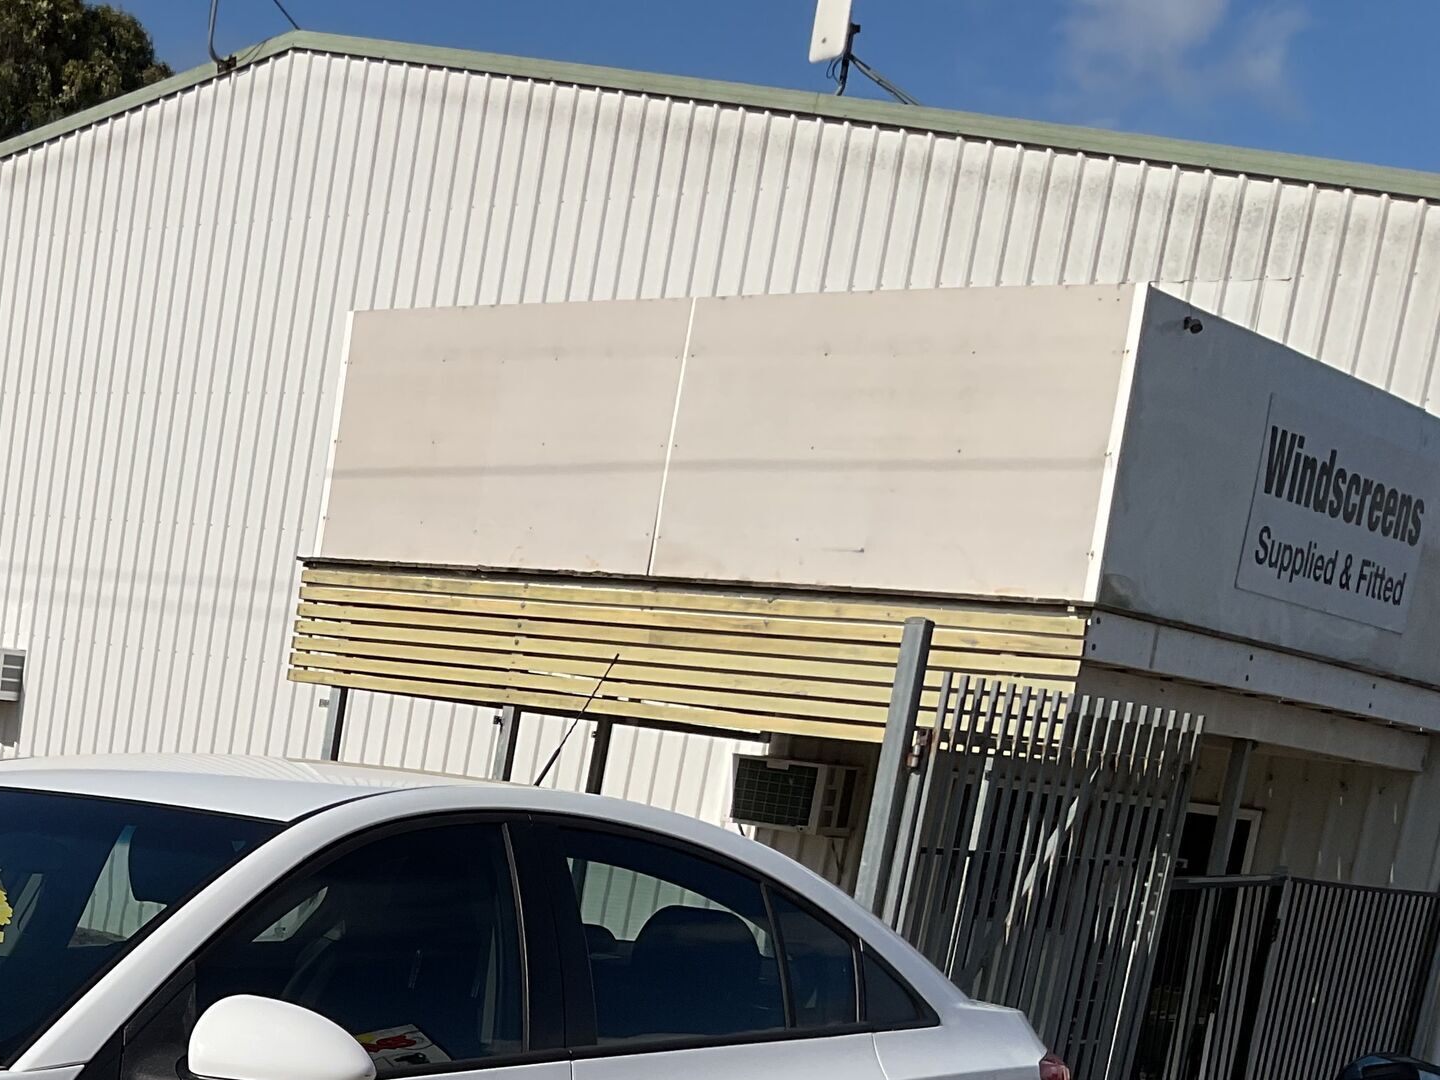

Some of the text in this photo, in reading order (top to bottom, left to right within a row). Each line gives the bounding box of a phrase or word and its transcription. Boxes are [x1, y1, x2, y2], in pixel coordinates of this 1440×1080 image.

[1264, 425, 1425, 546] Windscreens
[1255, 526, 1407, 606] Supplied & Fitted
